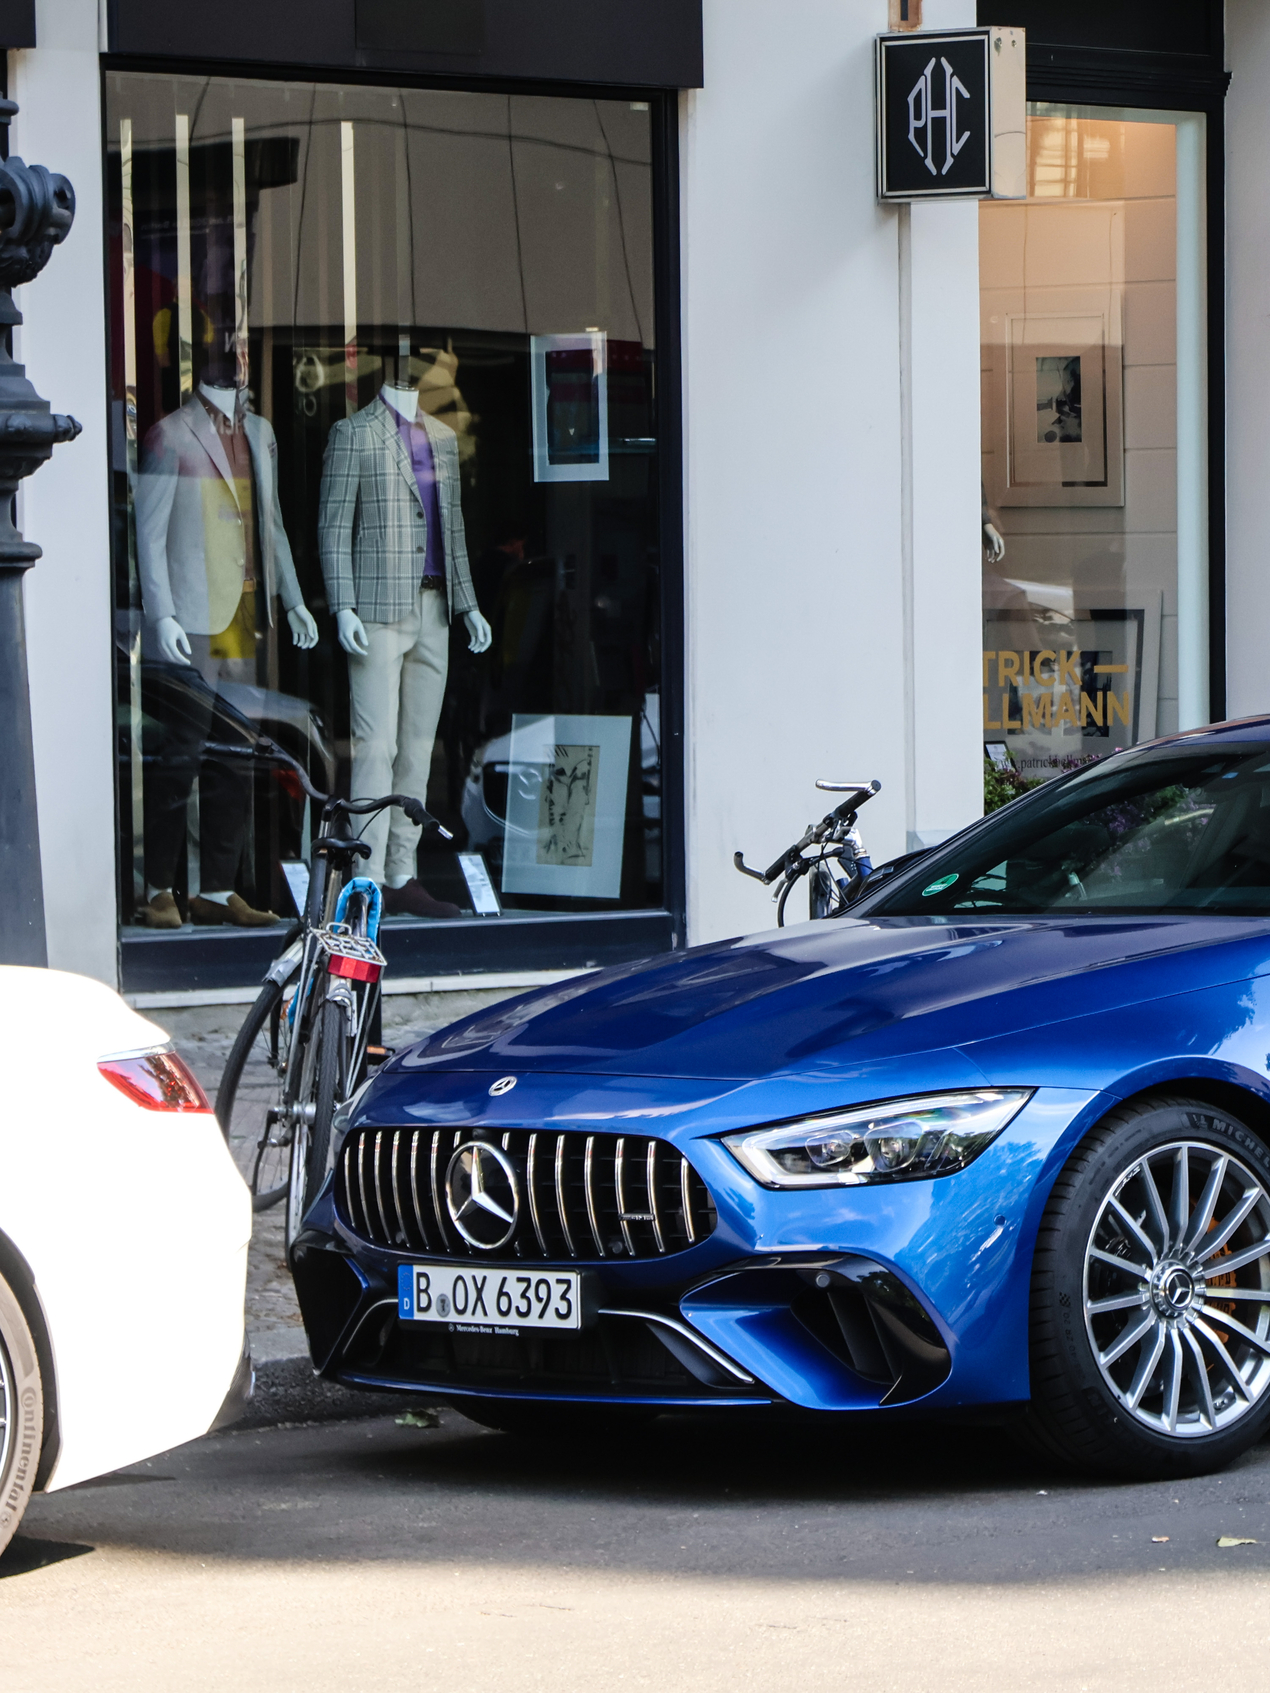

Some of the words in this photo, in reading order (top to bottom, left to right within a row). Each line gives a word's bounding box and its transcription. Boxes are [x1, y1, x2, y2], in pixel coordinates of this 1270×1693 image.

[983, 650, 1083, 687] TRICK
[983, 690, 1130, 730] LLMANN
[403, 1297, 410, 1310] D
[416, 1271, 432, 1313] B
[452, 1274, 488, 1317] OX
[496, 1276, 573, 1320] 6393
[6, 1386, 37, 1512] Continental
